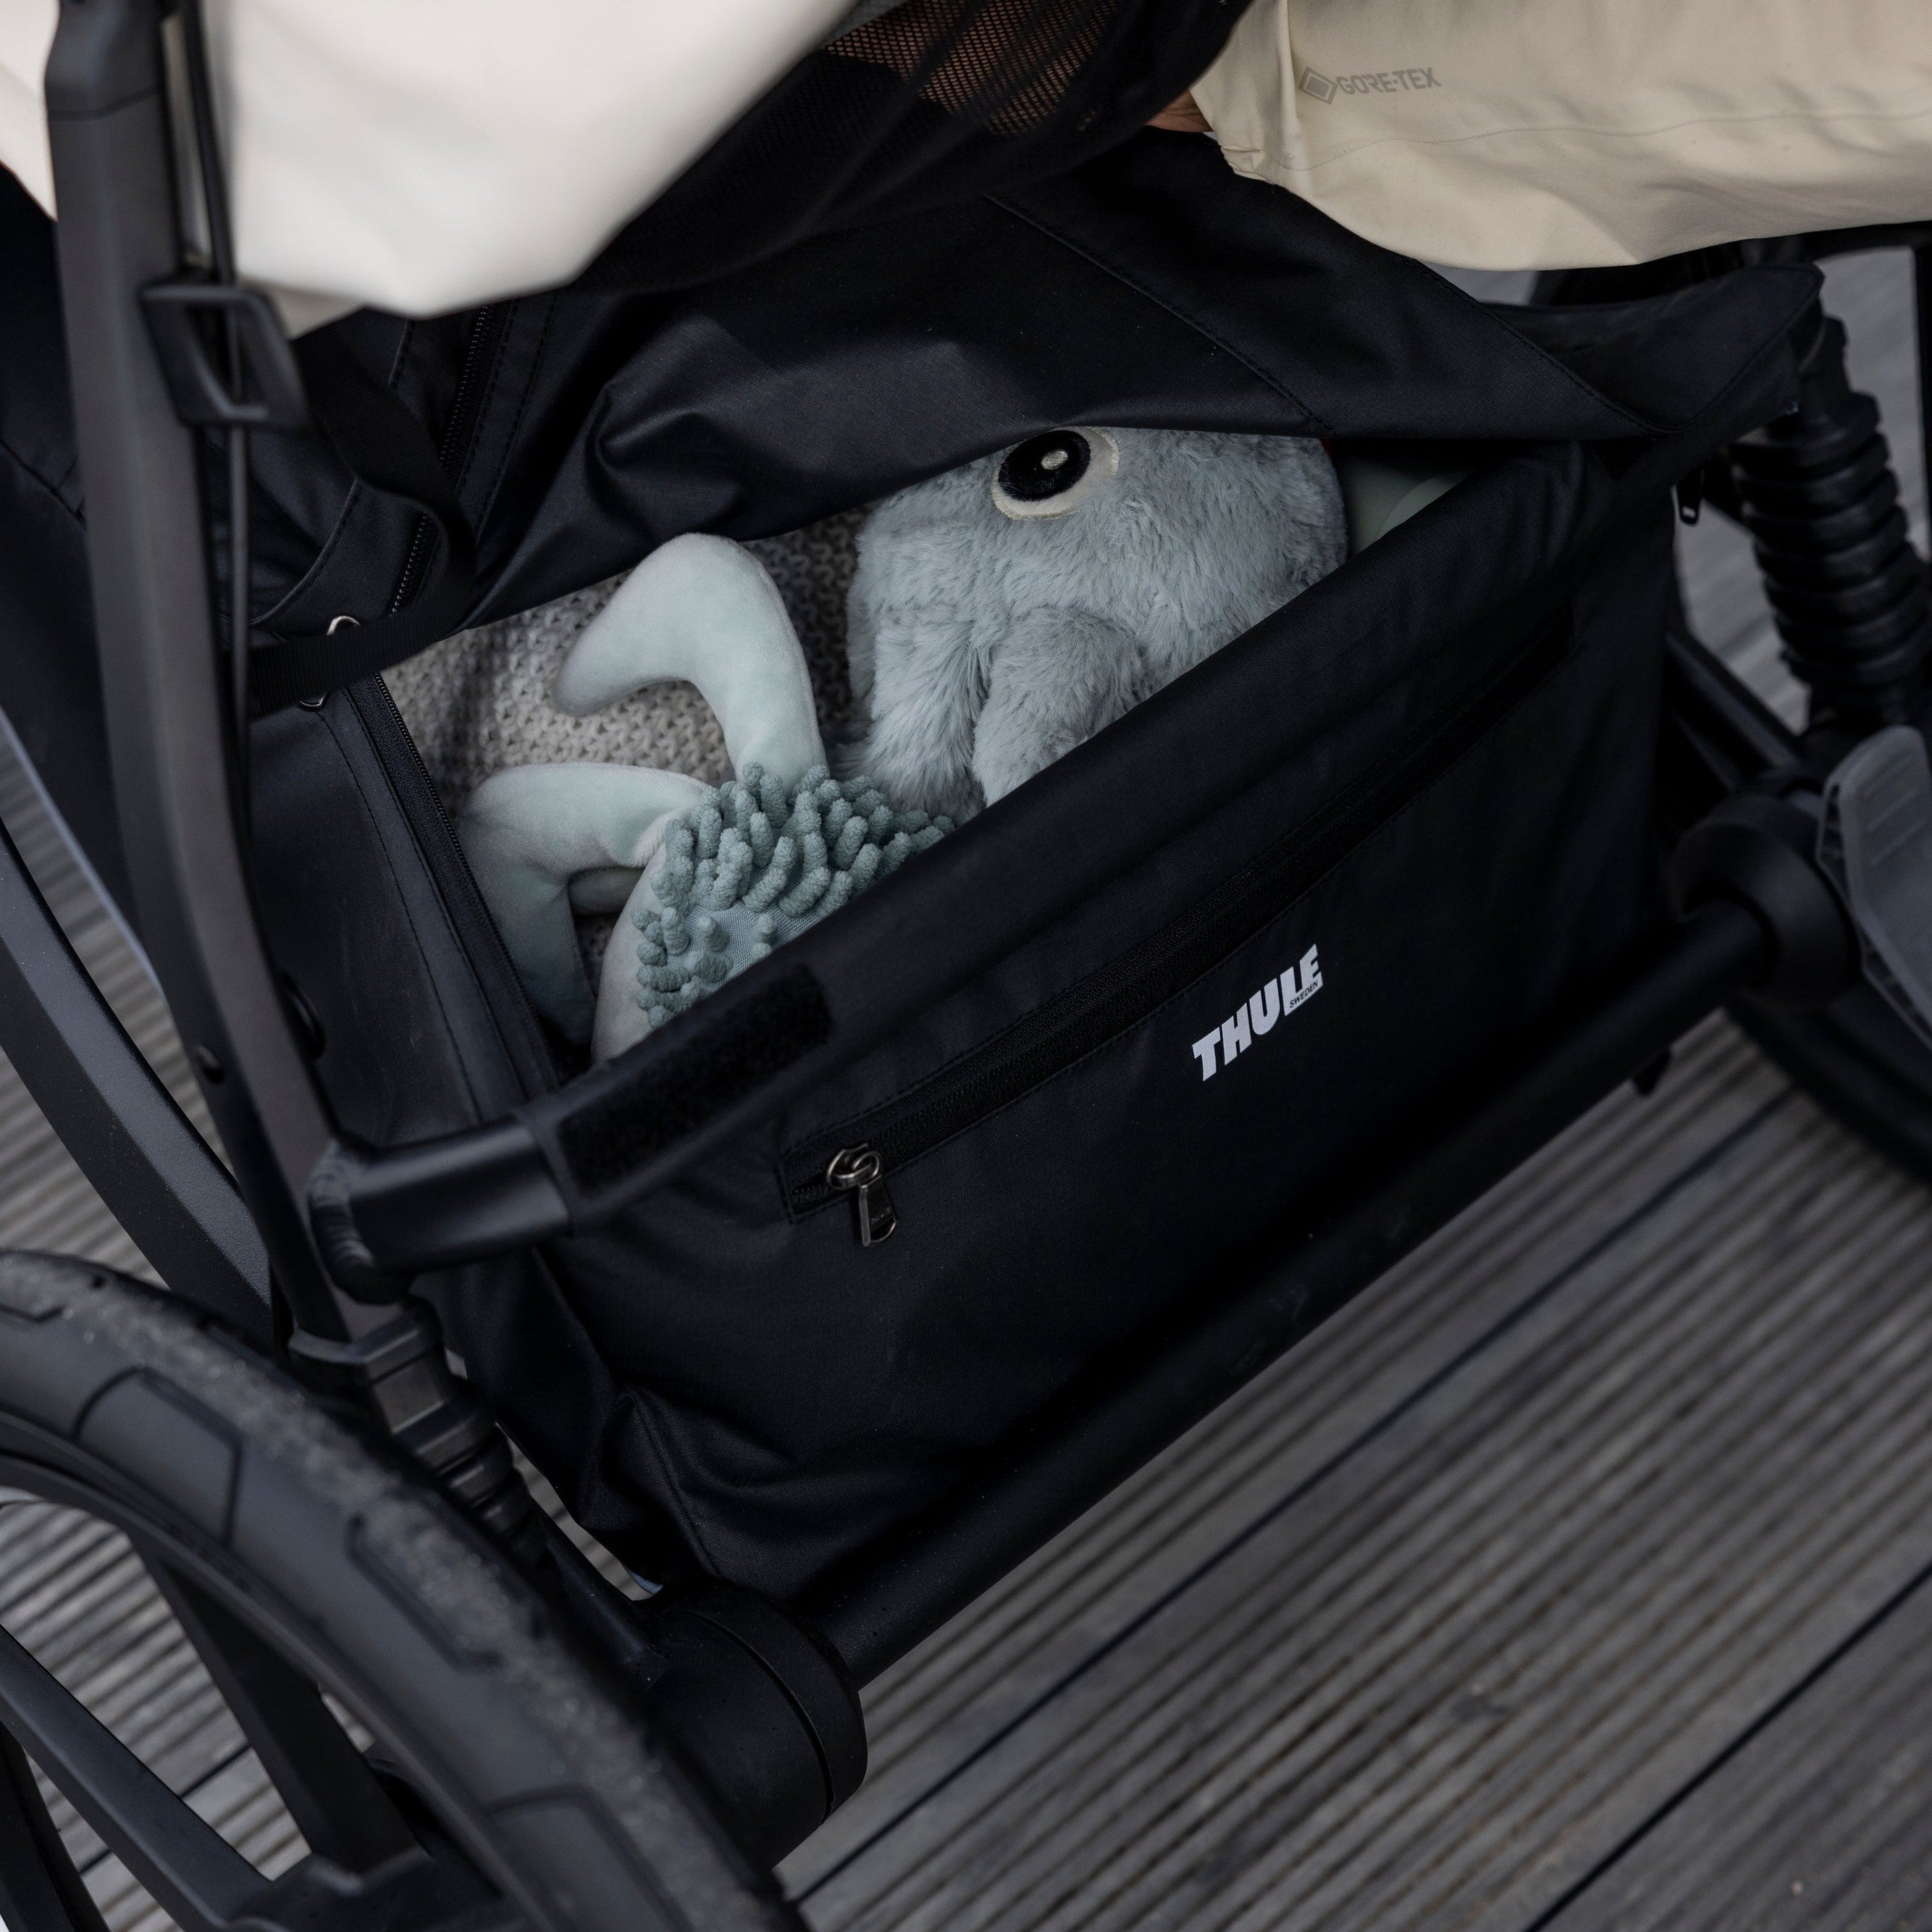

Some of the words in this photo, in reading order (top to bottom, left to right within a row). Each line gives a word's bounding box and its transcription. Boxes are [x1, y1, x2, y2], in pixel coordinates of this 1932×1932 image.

[1337, 67, 1441, 95] GORE-TEX
[1289, 980, 1319, 1008] SWEDEN
[1192, 944, 1323, 1081] THULE
